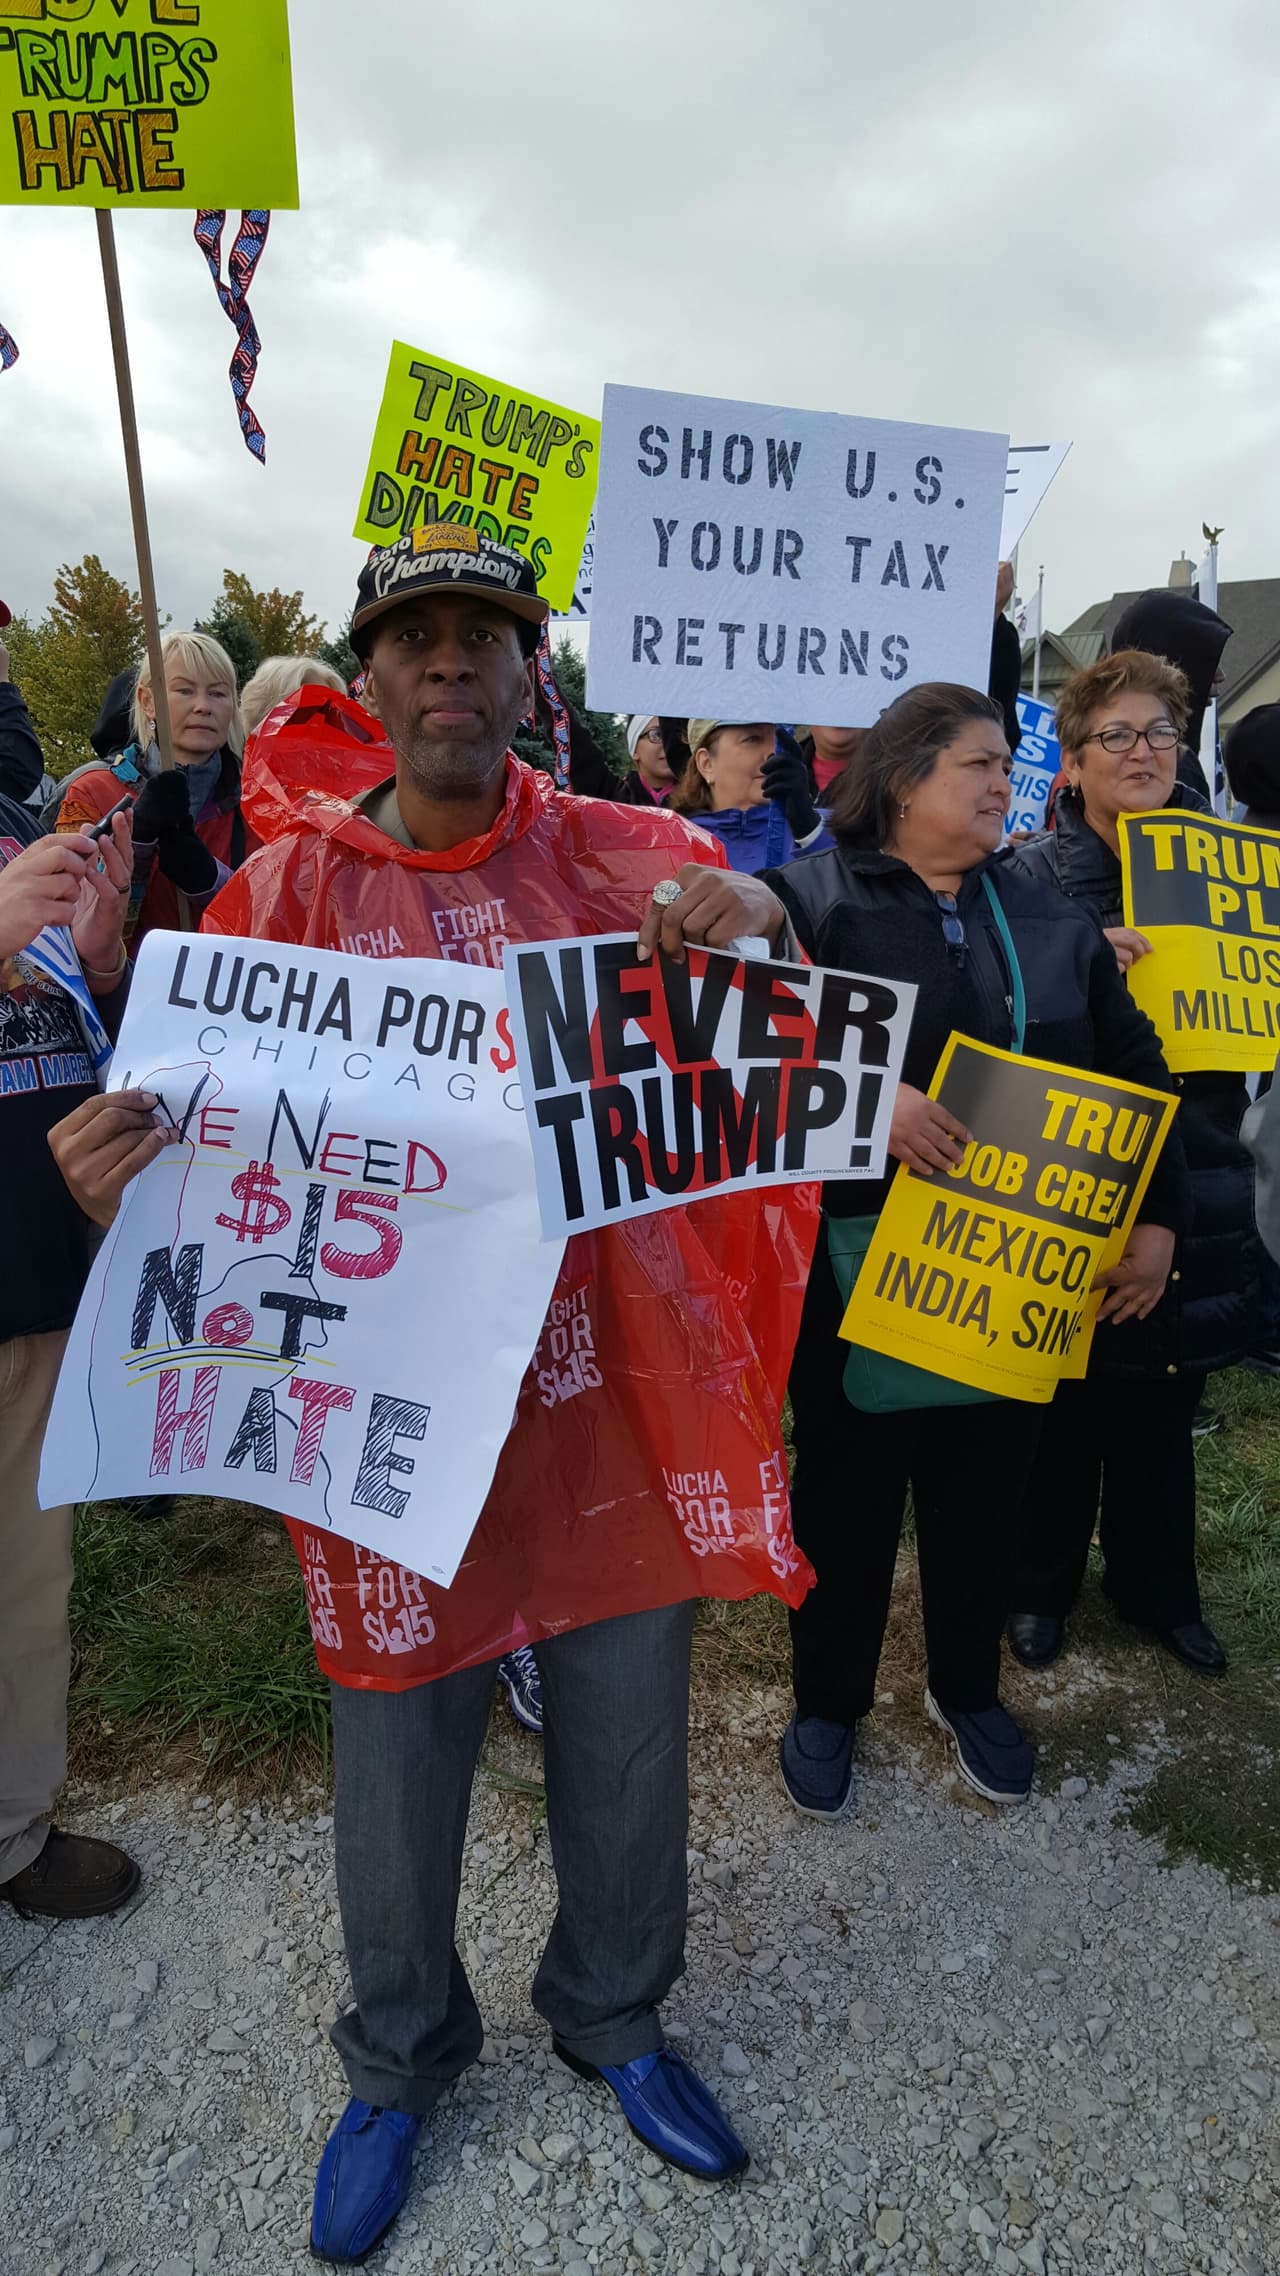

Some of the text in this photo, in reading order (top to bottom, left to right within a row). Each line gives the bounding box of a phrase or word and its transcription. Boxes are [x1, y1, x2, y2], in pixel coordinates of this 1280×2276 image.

[12, 108, 184, 194] HATE
[409, 360, 594, 478] TRUMP'S
[396, 430, 539, 520] HATE
[637, 425, 802, 491] SHOW
[845, 448, 967, 506] U.S.
[652, 517, 949, 592] YOUR TAX
[632, 615, 910, 682] RETURNS
[432, 899, 505, 941] FIGHT
[168, 945, 353, 1041] LUCHA
[376, 985, 486, 1064] POR
[517, 940, 898, 1090] NEVER
[1172, 988, 1280, 1039] MILLI
[266, 1087, 448, 1194] NEED
[535, 1066, 884, 1221] TRUMP!
[947, 1138, 1029, 1196] JOB
[1041, 1088, 1152, 1165] TRU
[215, 1160, 403, 1280] $15
[921, 1199, 1092, 1304] MEXICO,
[874, 1251, 999, 1348] INDIA,
[150, 1365, 431, 1519] HATE
[662, 1467, 729, 1496] LUCHA
[356, 1567, 426, 1609] FOR
